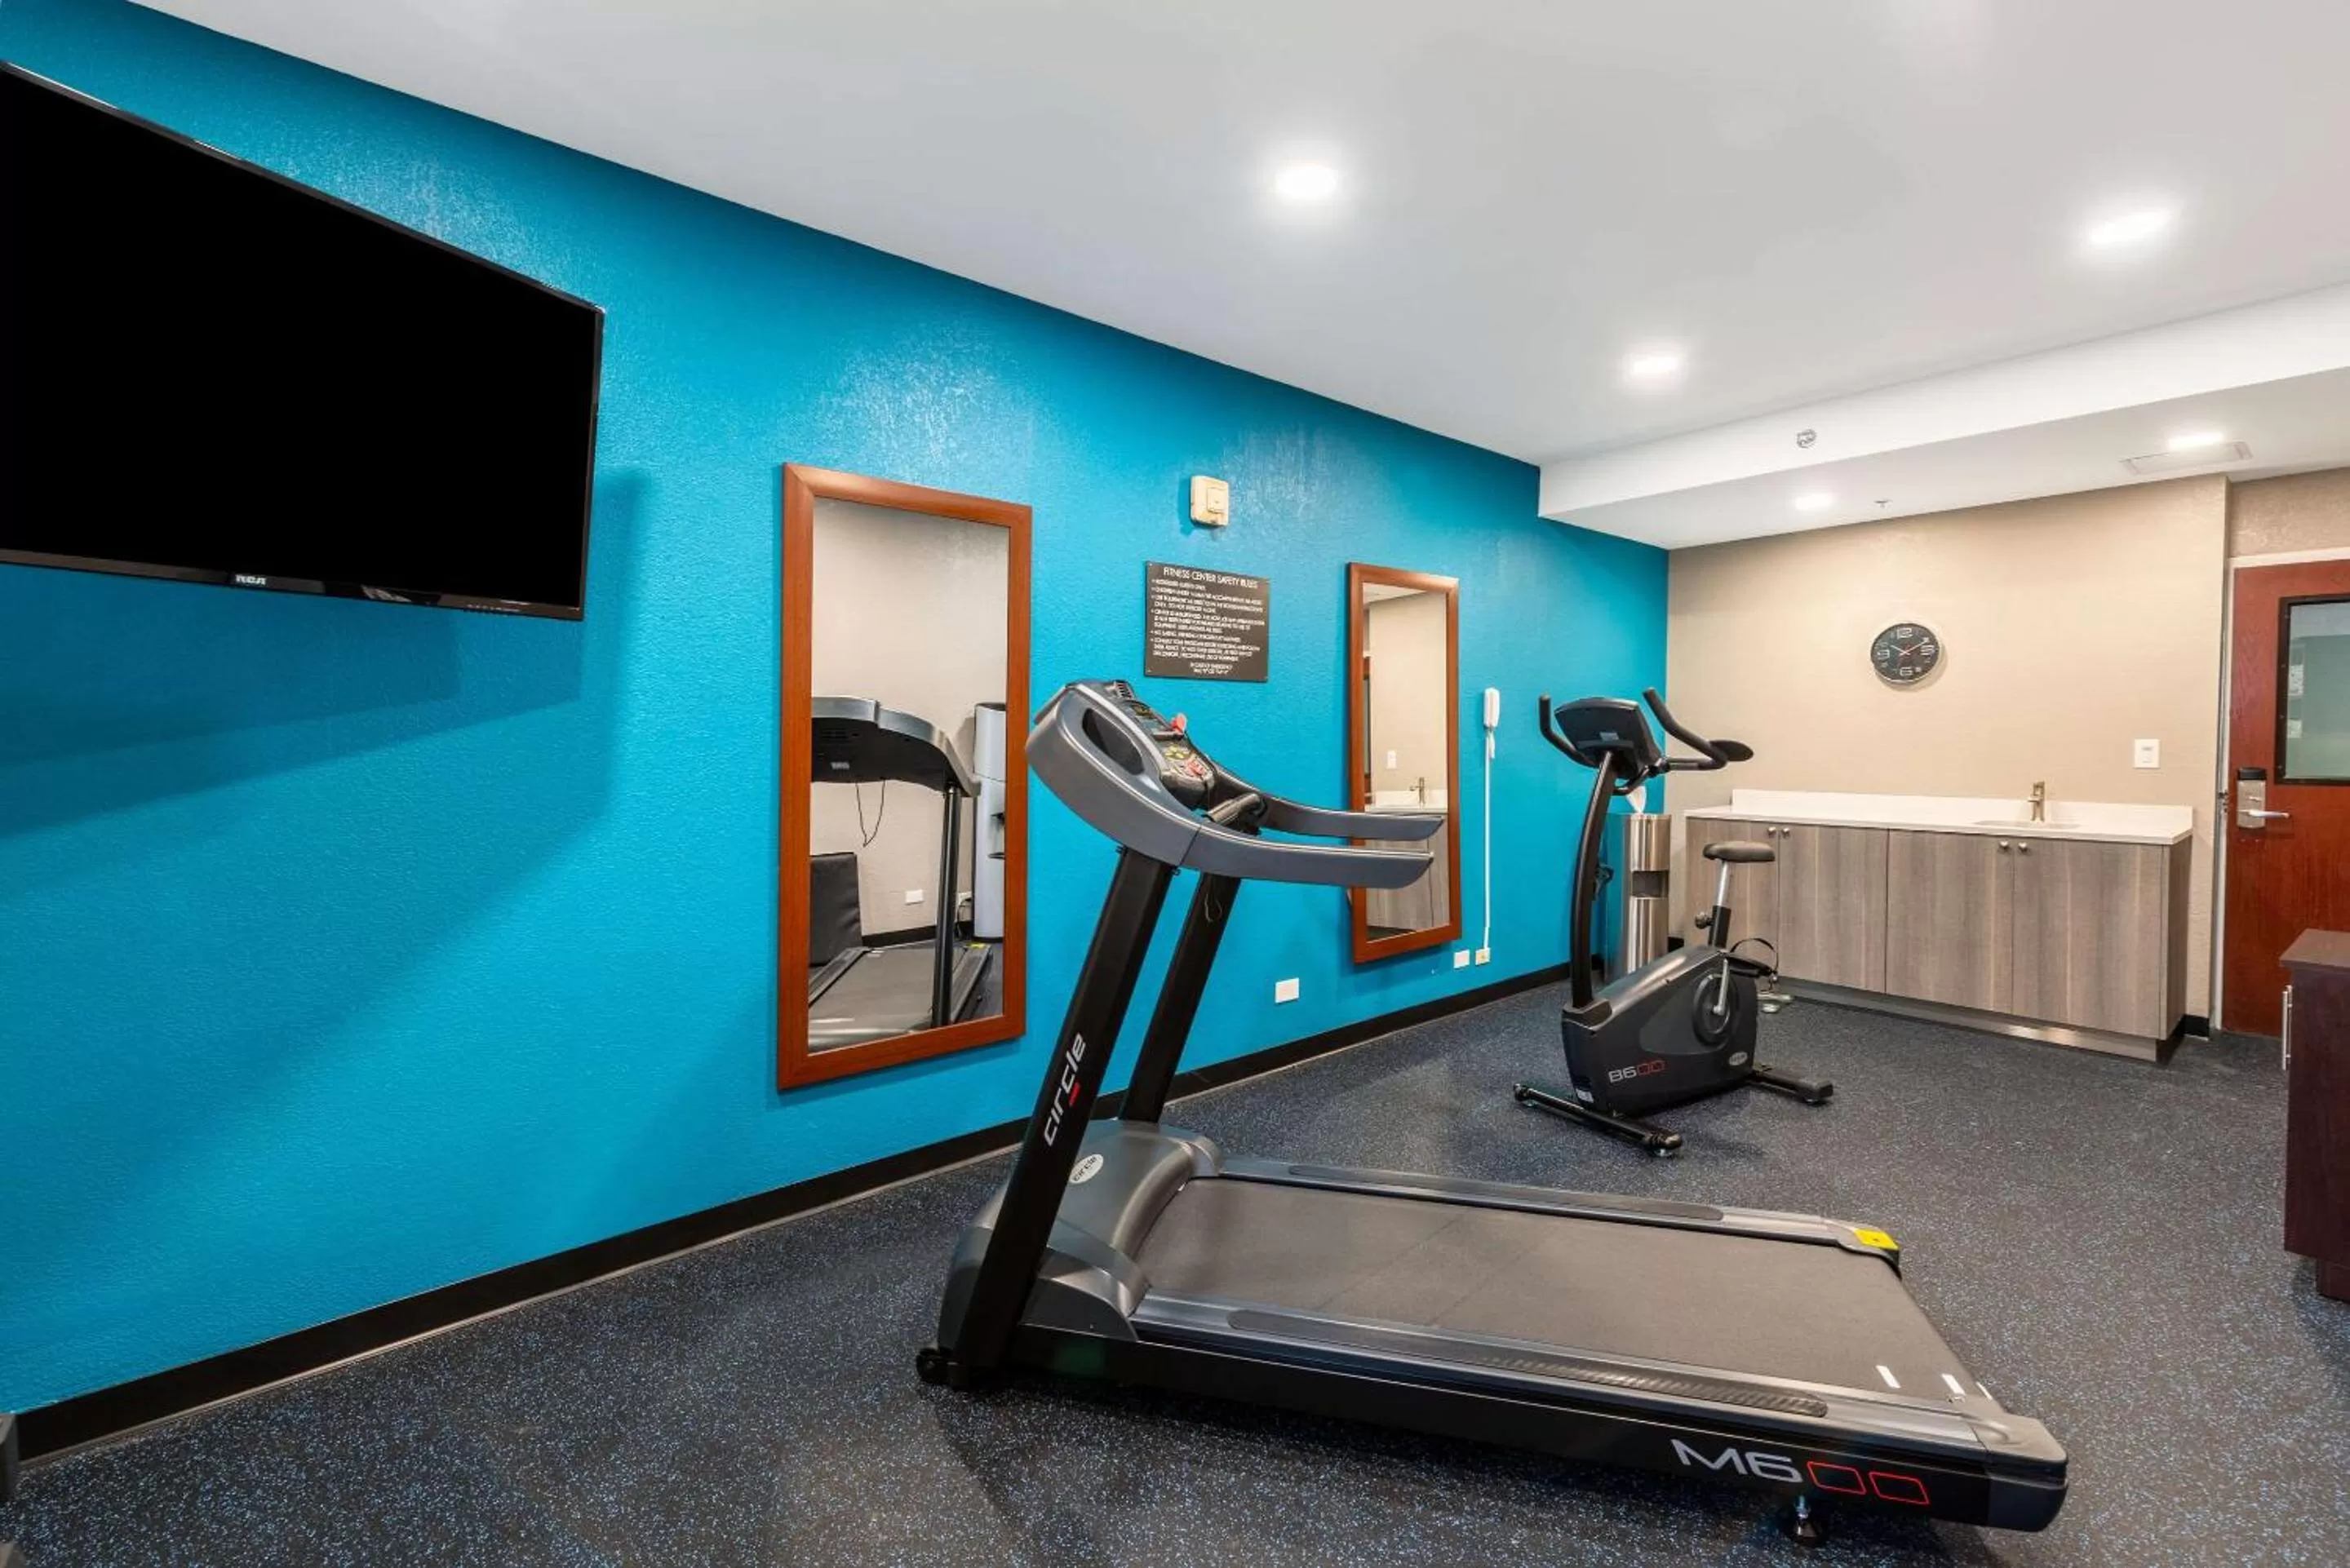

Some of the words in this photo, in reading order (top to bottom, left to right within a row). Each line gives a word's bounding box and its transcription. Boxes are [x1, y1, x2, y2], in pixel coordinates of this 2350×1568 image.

[1164, 567, 1190, 579] FITNESS
[1191, 571, 1216, 582] CENTER
[1217, 575, 1239, 587] SAFETY
[1608, 1057, 1665, 1083] B600
[1044, 1032, 1086, 1146] circle
[1073, 1157, 1097, 1182] circle
[1670, 1438, 1929, 1505] M600
